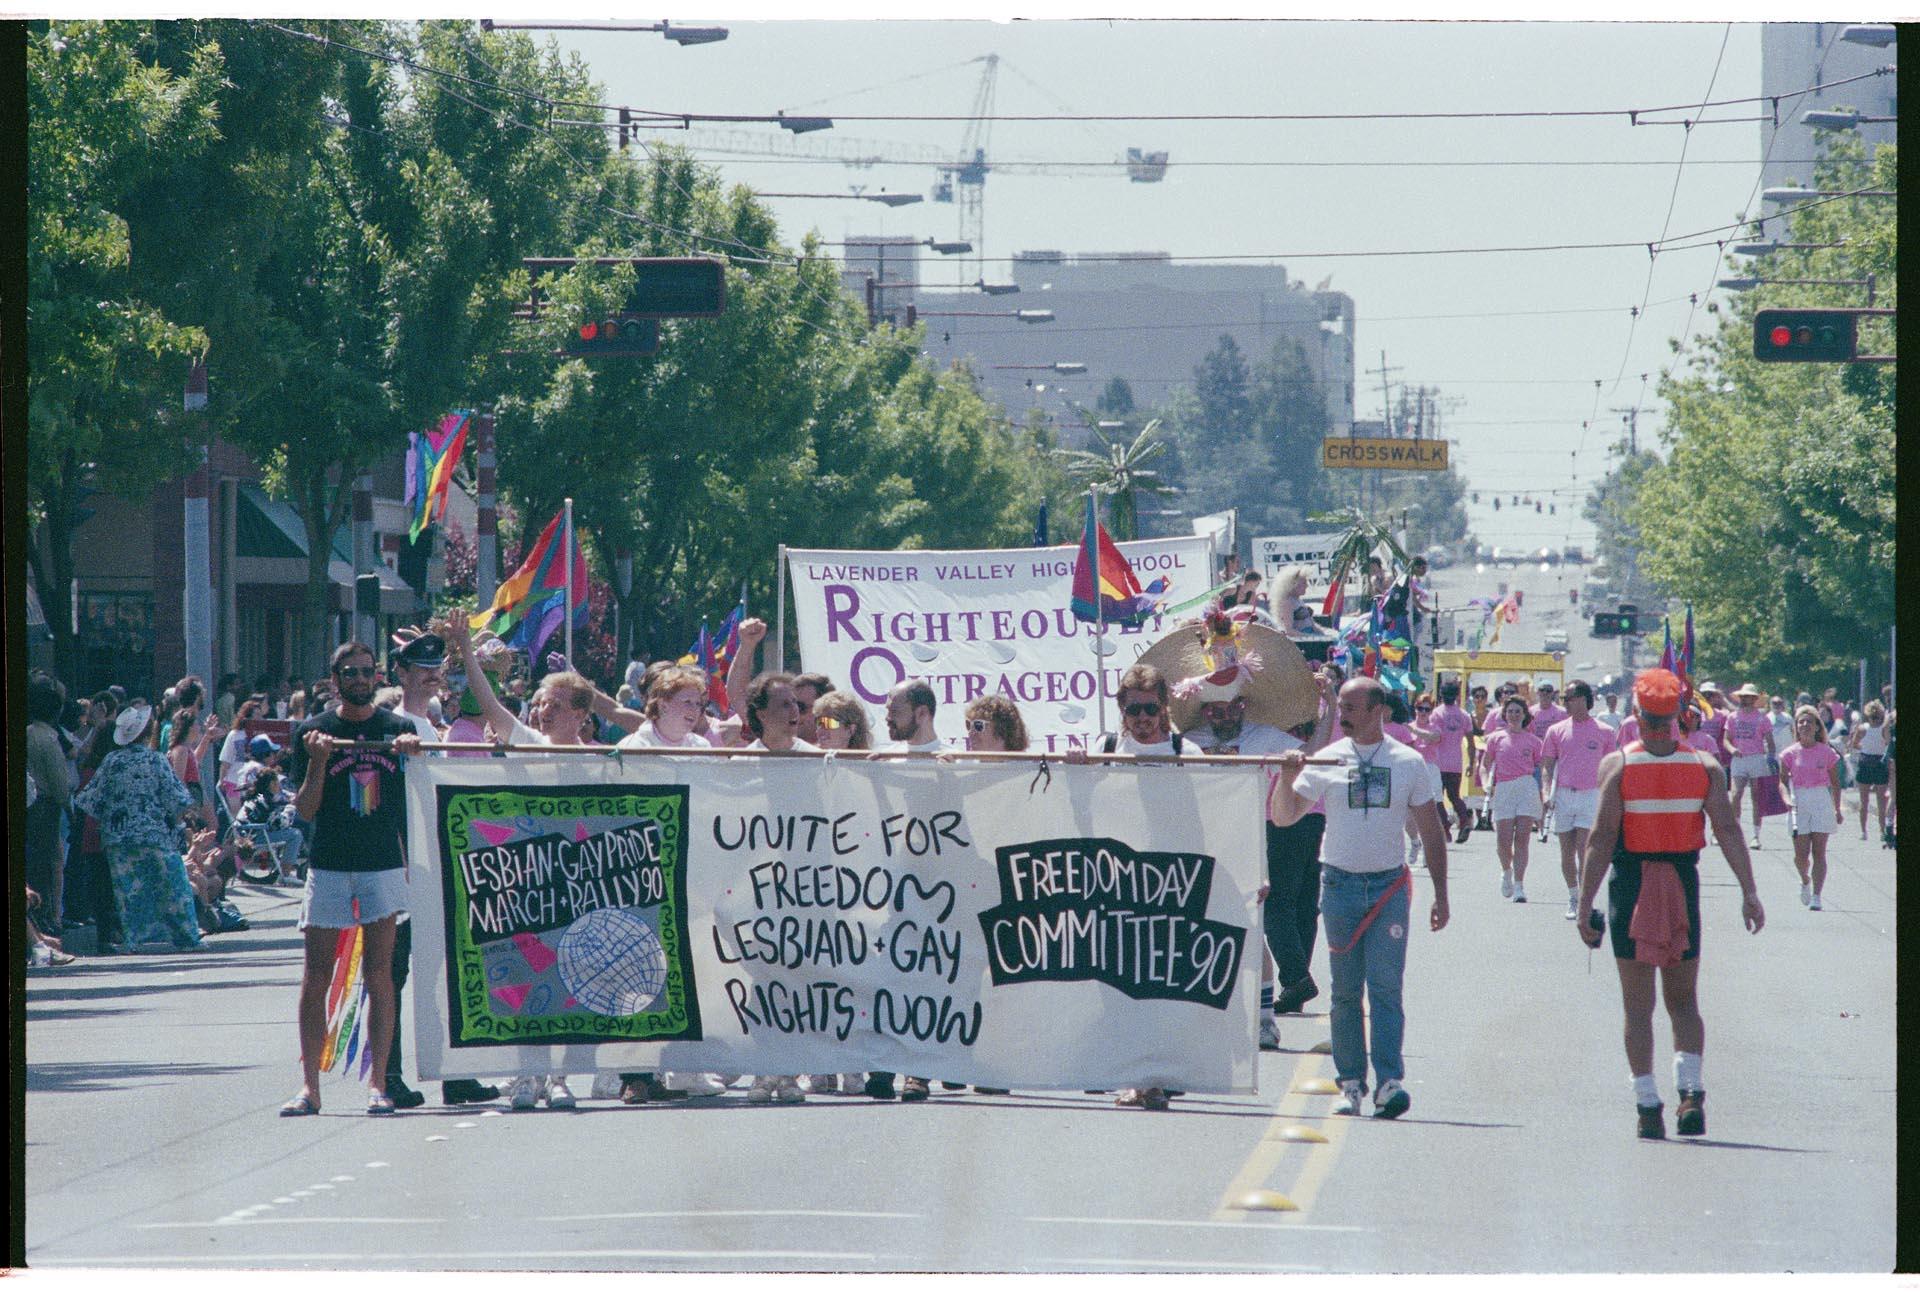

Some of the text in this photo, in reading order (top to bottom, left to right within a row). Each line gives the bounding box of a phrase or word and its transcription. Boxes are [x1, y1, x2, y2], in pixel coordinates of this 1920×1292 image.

[1327, 445, 1443, 461] CROSSWALK
[808, 565, 919, 581] LAVENDER
[935, 564, 1016, 581] VALLEY
[1129, 554, 1186, 572] HOOL
[824, 584, 1169, 642] RIGHTEOUY
[850, 646, 1122, 704] OTRAGEOU
[524, 800, 574, 816] FOR
[713, 810, 970, 856] UNITE FOR
[469, 887, 555, 934] MARCH
[749, 861, 956, 923] FREEDOM
[725, 978, 983, 1047] RIGHTS NOW
